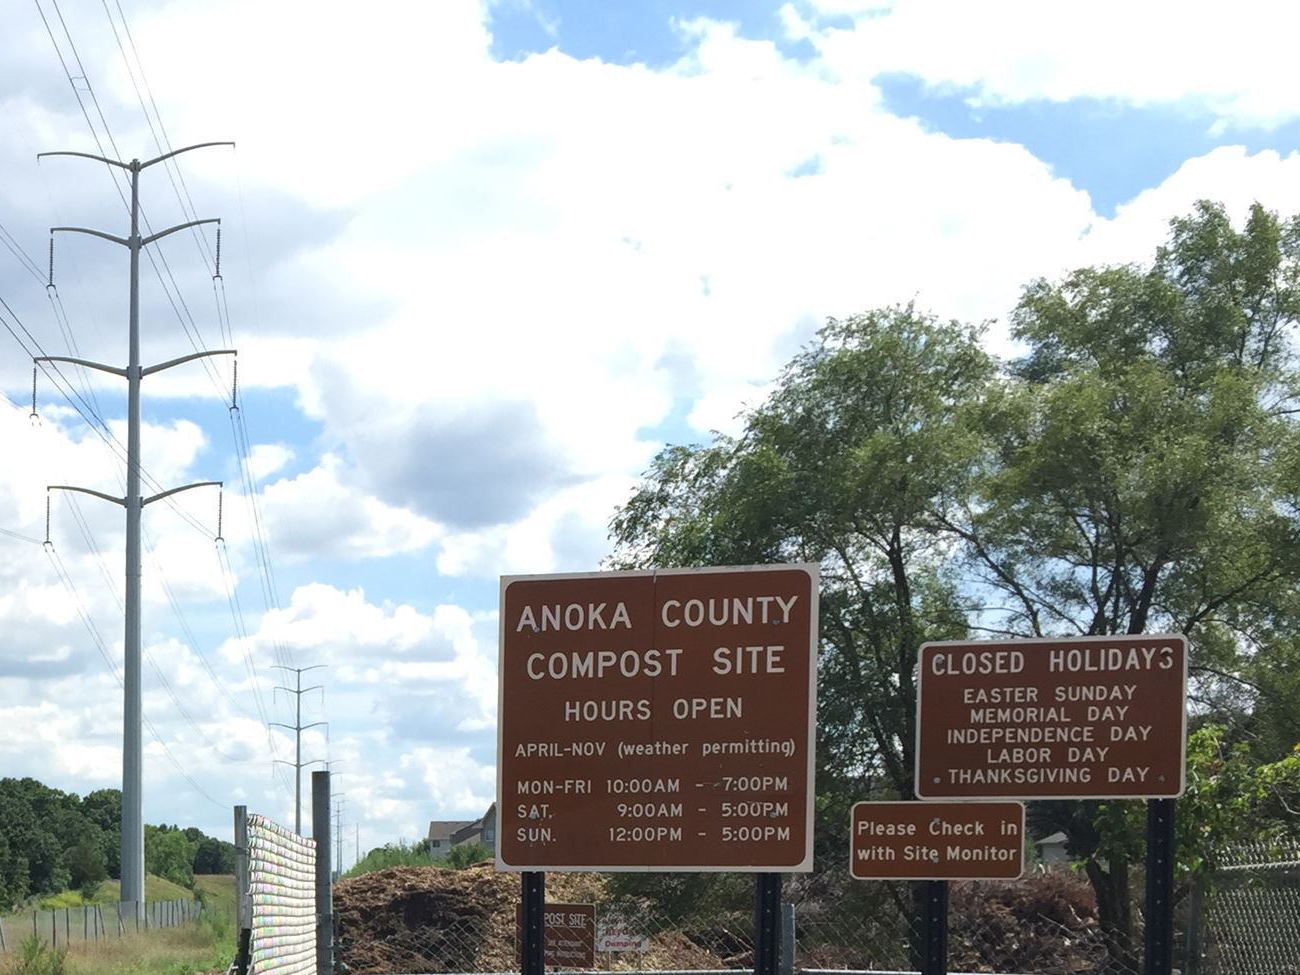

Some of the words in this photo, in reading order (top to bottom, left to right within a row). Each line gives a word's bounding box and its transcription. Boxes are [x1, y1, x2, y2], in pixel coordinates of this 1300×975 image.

[516, 602, 632, 632] ANOKA
[661, 596, 798, 627] COUNTY
[527, 649, 683, 680] COMPOST
[713, 646, 785, 675] SITE
[932, 651, 1024, 676] CLOSED
[1050, 647, 1174, 672] HOLIDAYS
[964, 687, 1038, 703] EASTER
[1055, 685, 1137, 701] SUNDAY
[565, 700, 650, 721] HOURS
[673, 698, 742, 719] OPEN
[970, 707, 1070, 723] MEMORIAL
[1087, 706, 1128, 721] DAY
[948, 727, 1093, 744] INDEPENDENCE
[1110, 726, 1152, 741] DAY
[515, 742, 605, 757] APRIL-NOV
[618, 741, 689, 759] (weather
[702, 739, 795, 757] permitting)
[987, 748, 1051, 763] LABOR
[1068, 747, 1109, 762] DAY
[948, 768, 1091, 784] THANKSGIVING
[1108, 767, 1150, 782] DAY
[518, 780, 591, 794] MON-FRI
[607, 779, 680, 793] 10:00AM
[722, 777, 787, 792] 7:00PM
[617, 803, 682, 817] 9:00AM
[722, 802, 788, 817] 5:00PM
[517, 827, 556, 842] SUN.
[609, 827, 682, 841] 12:00PM
[722, 827, 790, 841] 5:00PM
[858, 821, 916, 836] Please
[929, 821, 984, 836] Check
[1001, 821, 1017, 836] in
[858, 847, 895, 861] with
[903, 846, 938, 861] Site
[947, 846, 1017, 861] Monitor
